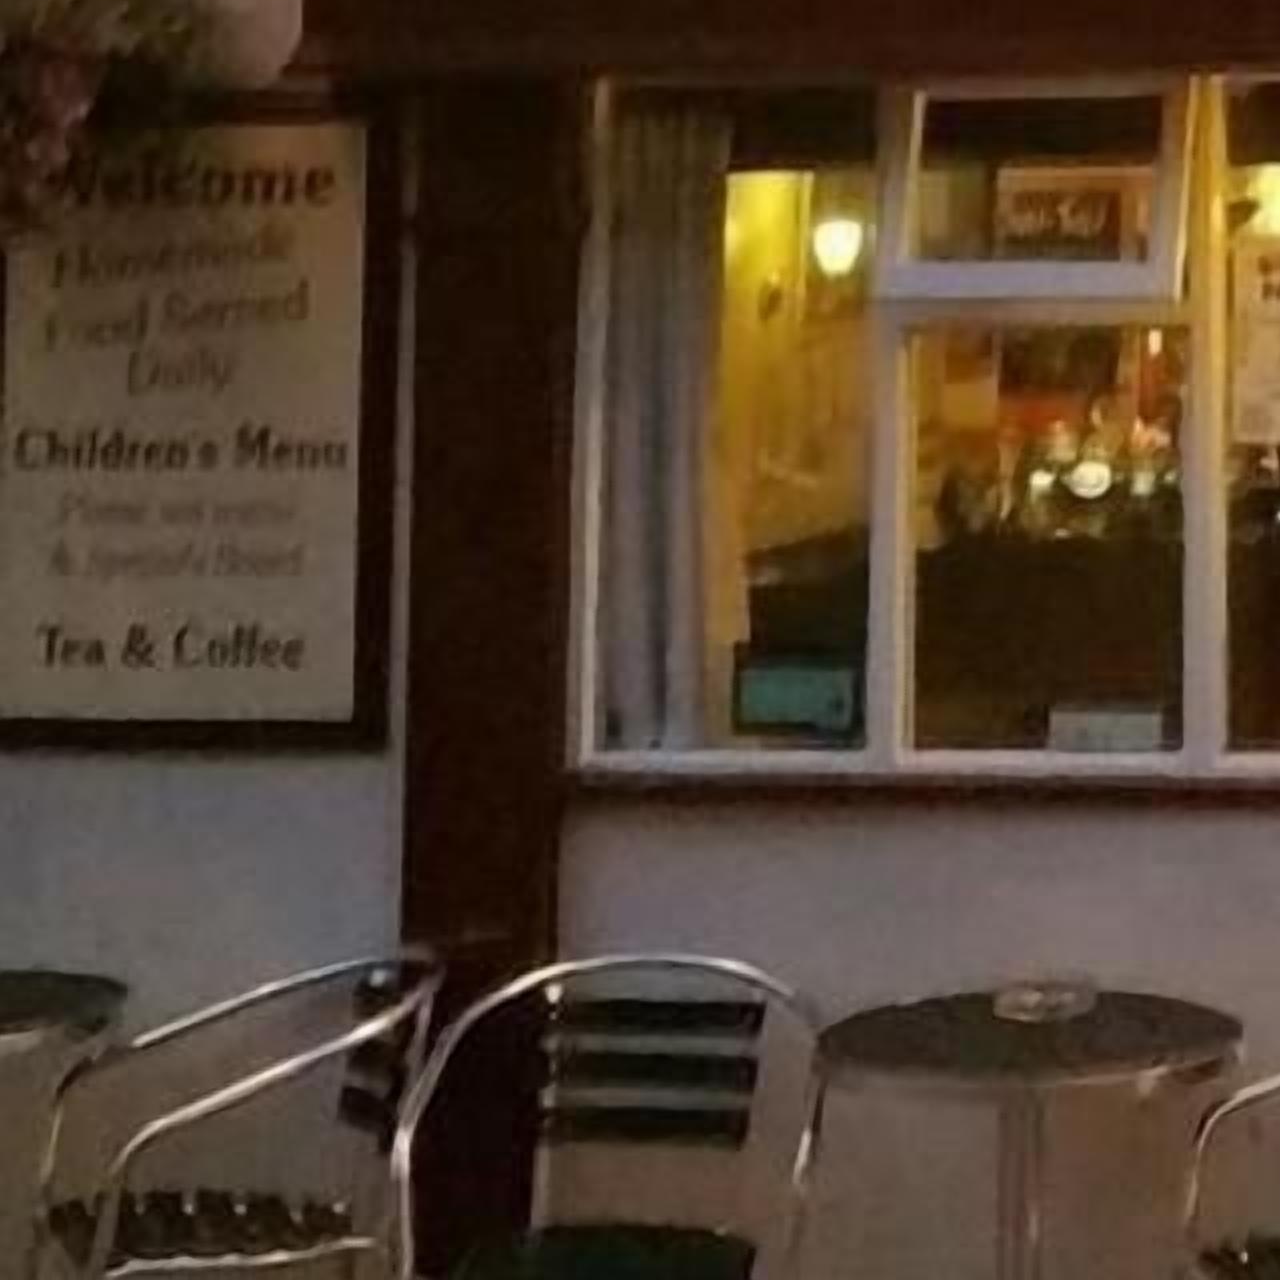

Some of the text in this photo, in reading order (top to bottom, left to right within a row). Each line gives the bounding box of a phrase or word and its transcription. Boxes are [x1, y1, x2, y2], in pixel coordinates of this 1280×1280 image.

[232, 417, 349, 472] Menu
[36, 618, 306, 671] Tea & Coffee
